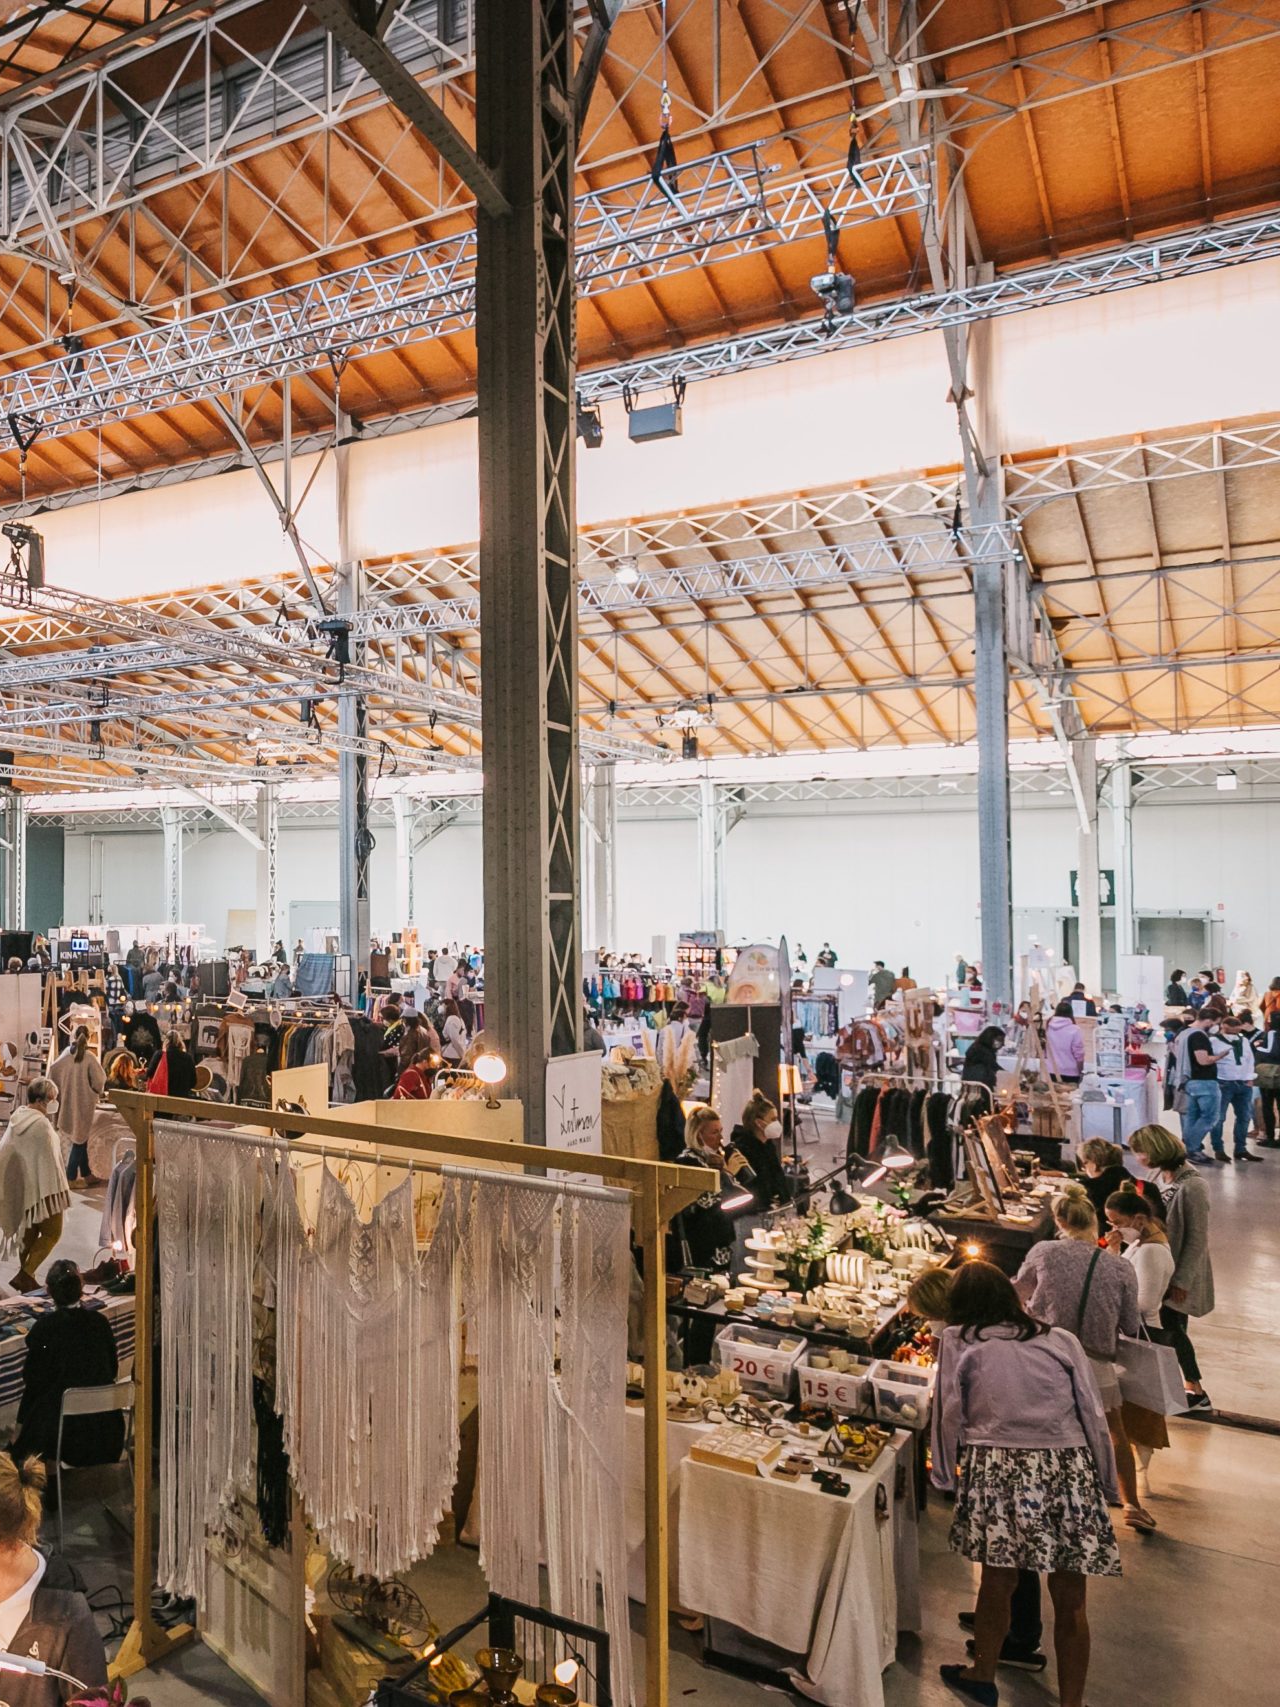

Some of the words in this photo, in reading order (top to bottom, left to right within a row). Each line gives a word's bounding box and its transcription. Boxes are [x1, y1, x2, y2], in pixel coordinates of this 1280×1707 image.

[733, 1358, 758, 1376] 20
[763, 1364, 776, 1380] €
[804, 1380, 829, 1398] 15
[835, 1386, 848, 1402] €
